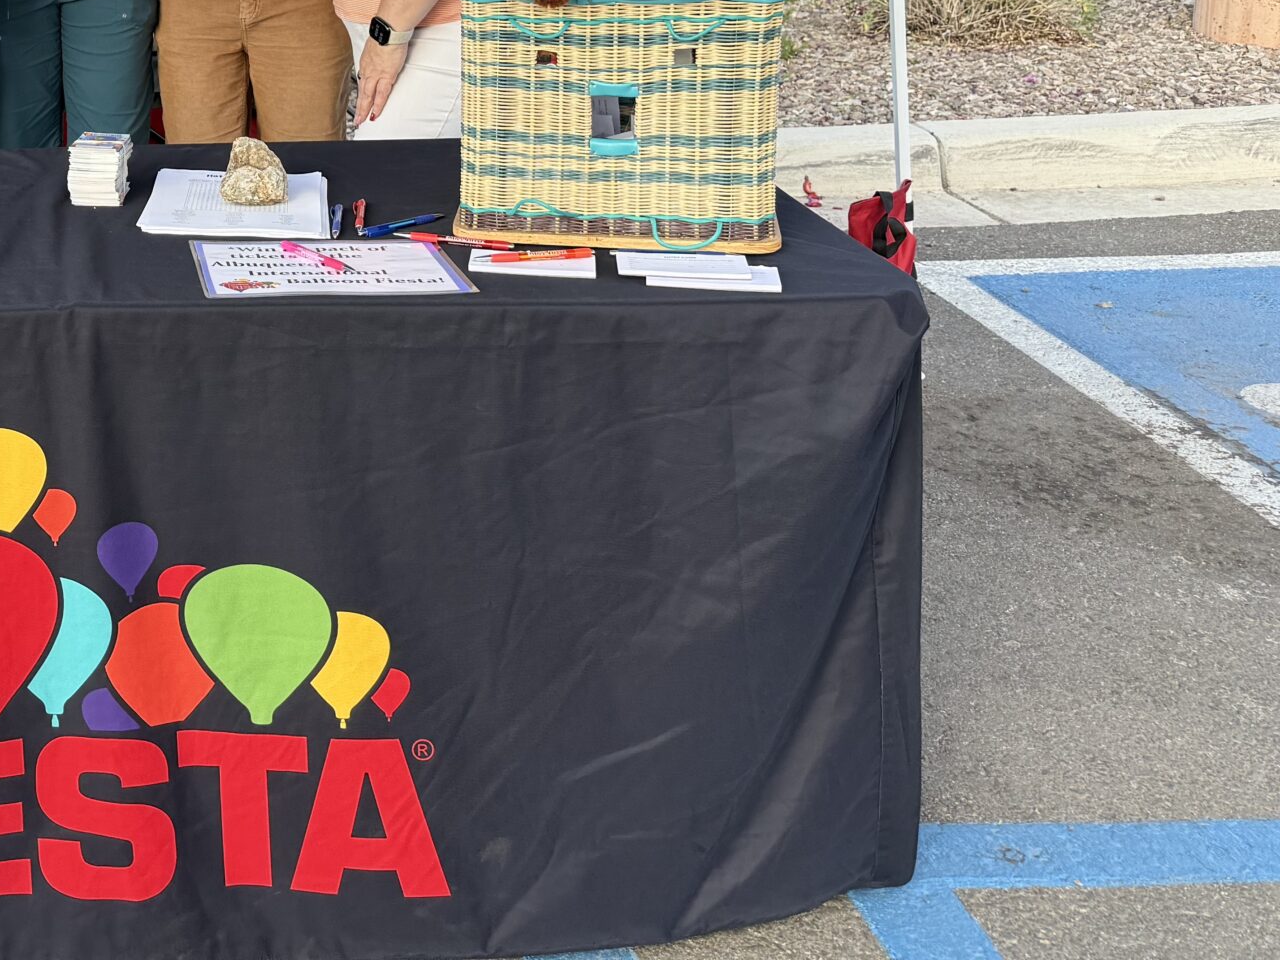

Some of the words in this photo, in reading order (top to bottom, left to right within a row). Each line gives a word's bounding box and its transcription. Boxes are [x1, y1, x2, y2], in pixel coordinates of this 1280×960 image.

[315, 245, 362, 255] pack
[367, 244, 388, 253] of
[285, 277, 368, 285] Balloon
[374, 276, 446, 285] Fiesta!
